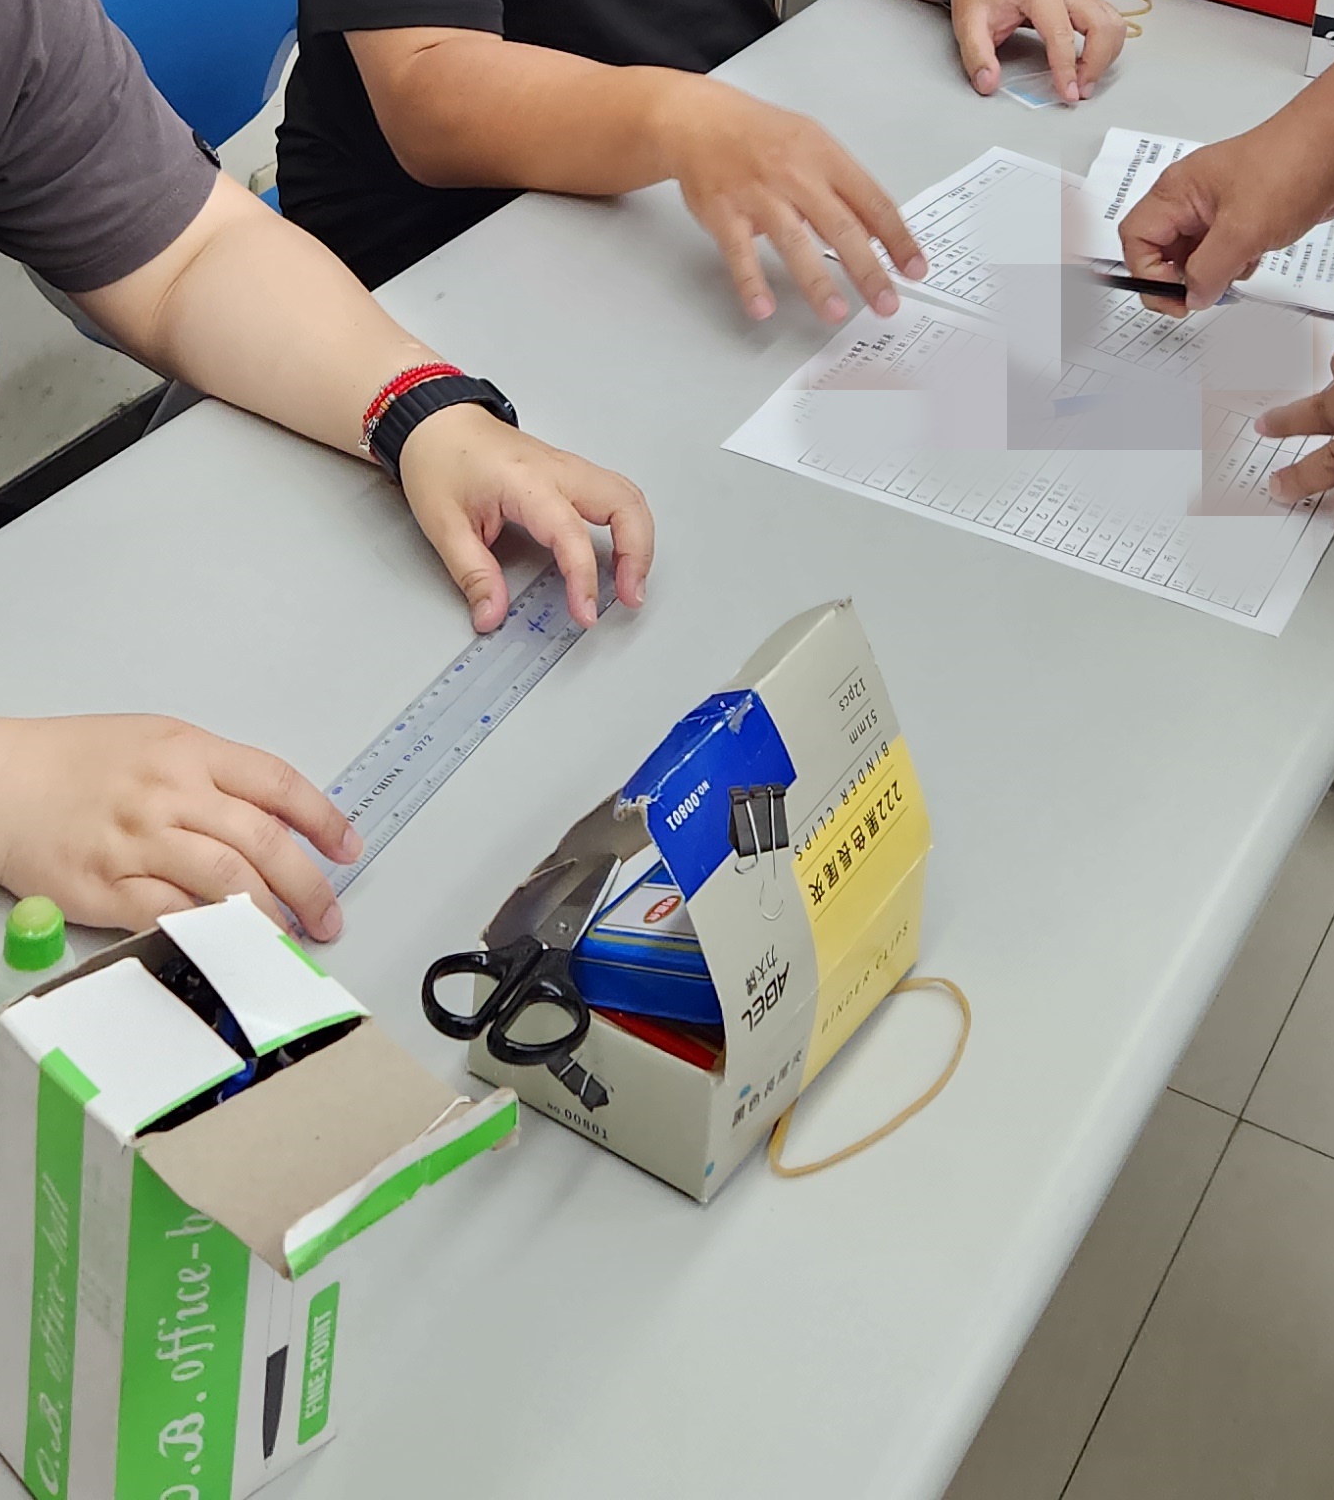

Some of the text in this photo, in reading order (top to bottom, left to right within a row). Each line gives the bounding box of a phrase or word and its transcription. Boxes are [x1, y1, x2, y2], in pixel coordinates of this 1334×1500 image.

[838, 677, 867, 712] 12pcs
[848, 708, 878, 745] 51mm
[359, 796, 374, 808] IN
[371, 768, 404, 795] CHINA
[665, 779, 710, 831] NO.00801
[794, 740, 890, 861] BINDER CLIPS
[808, 780, 903, 906] 222黑色長尾夾
[875, 921, 909, 970] CLIPS
[741, 961, 790, 1032] ABEL
[303, 1309, 333, 1419] FINE POINT
